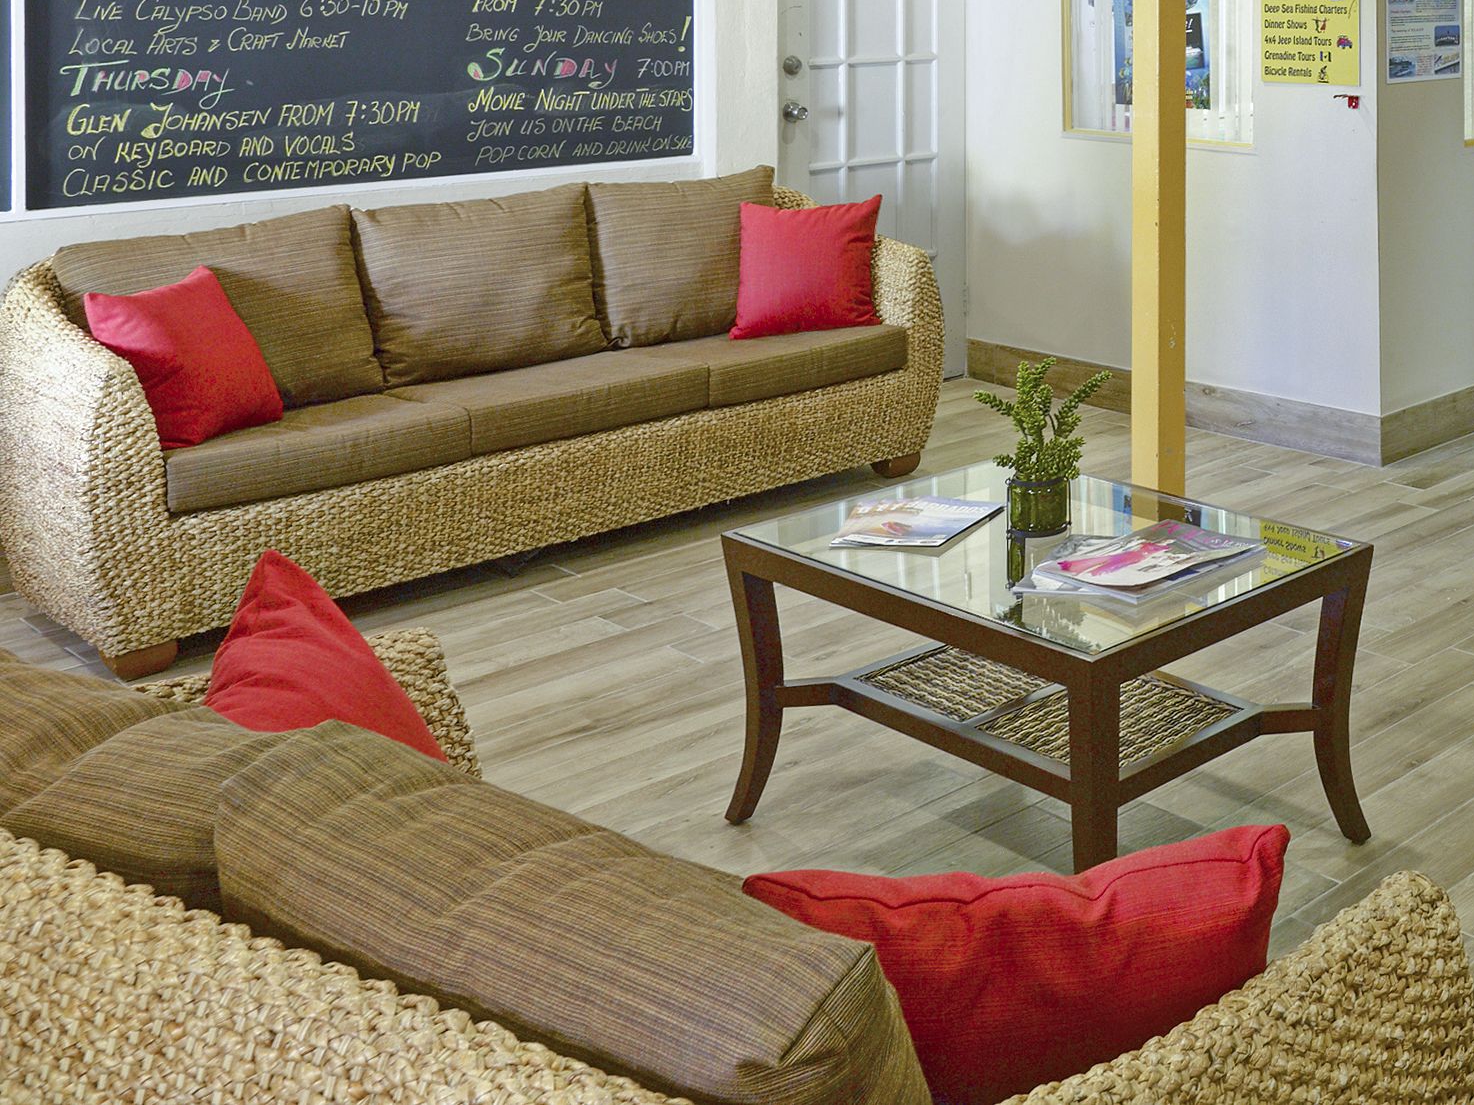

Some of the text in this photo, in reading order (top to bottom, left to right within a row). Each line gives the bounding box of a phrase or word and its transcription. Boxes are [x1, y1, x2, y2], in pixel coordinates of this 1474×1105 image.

[1264, 4, 1347, 14] Deep Sea Fishing Charters
[1264, 19, 1307, 29] Dinner Shows
[69, 29, 137, 55] LOCAL
[146, 32, 198, 55] ARTS
[228, 27, 285, 51] CRAFT
[286, 26, 350, 50] MARKET
[465, 23, 520, 42] BRING
[523, 25, 567, 53] YOUR
[573, 25, 633, 47] DANCING
[1264, 35, 1332, 46] 4x4 Jeep Island Tours
[467, 48, 618, 89] SUNDAY
[1264, 50, 1316, 61] Grenadine Tours
[60, 59, 235, 109] THURSDAY
[1264, 66, 1312, 76] Bicycle Rentals
[468, 89, 525, 113] MOVIE
[535, 87, 590, 111] NIGHT
[591, 92, 635, 111] UNDER
[636, 88, 656, 109] THE
[67, 103, 132, 135] GLEN
[140, 102, 272, 139] JOHANSEN
[278, 101, 335, 127] FROM
[466, 119, 514, 142] JOIN
[520, 117, 546, 135] US
[612, 115, 662, 132] BEACH
[68, 131, 355, 168] ON KEYBOARD AND VOCALS
[572, 141, 603, 157] AND
[63, 151, 441, 197] CLASSIC AND CONTEMPORARY POP
